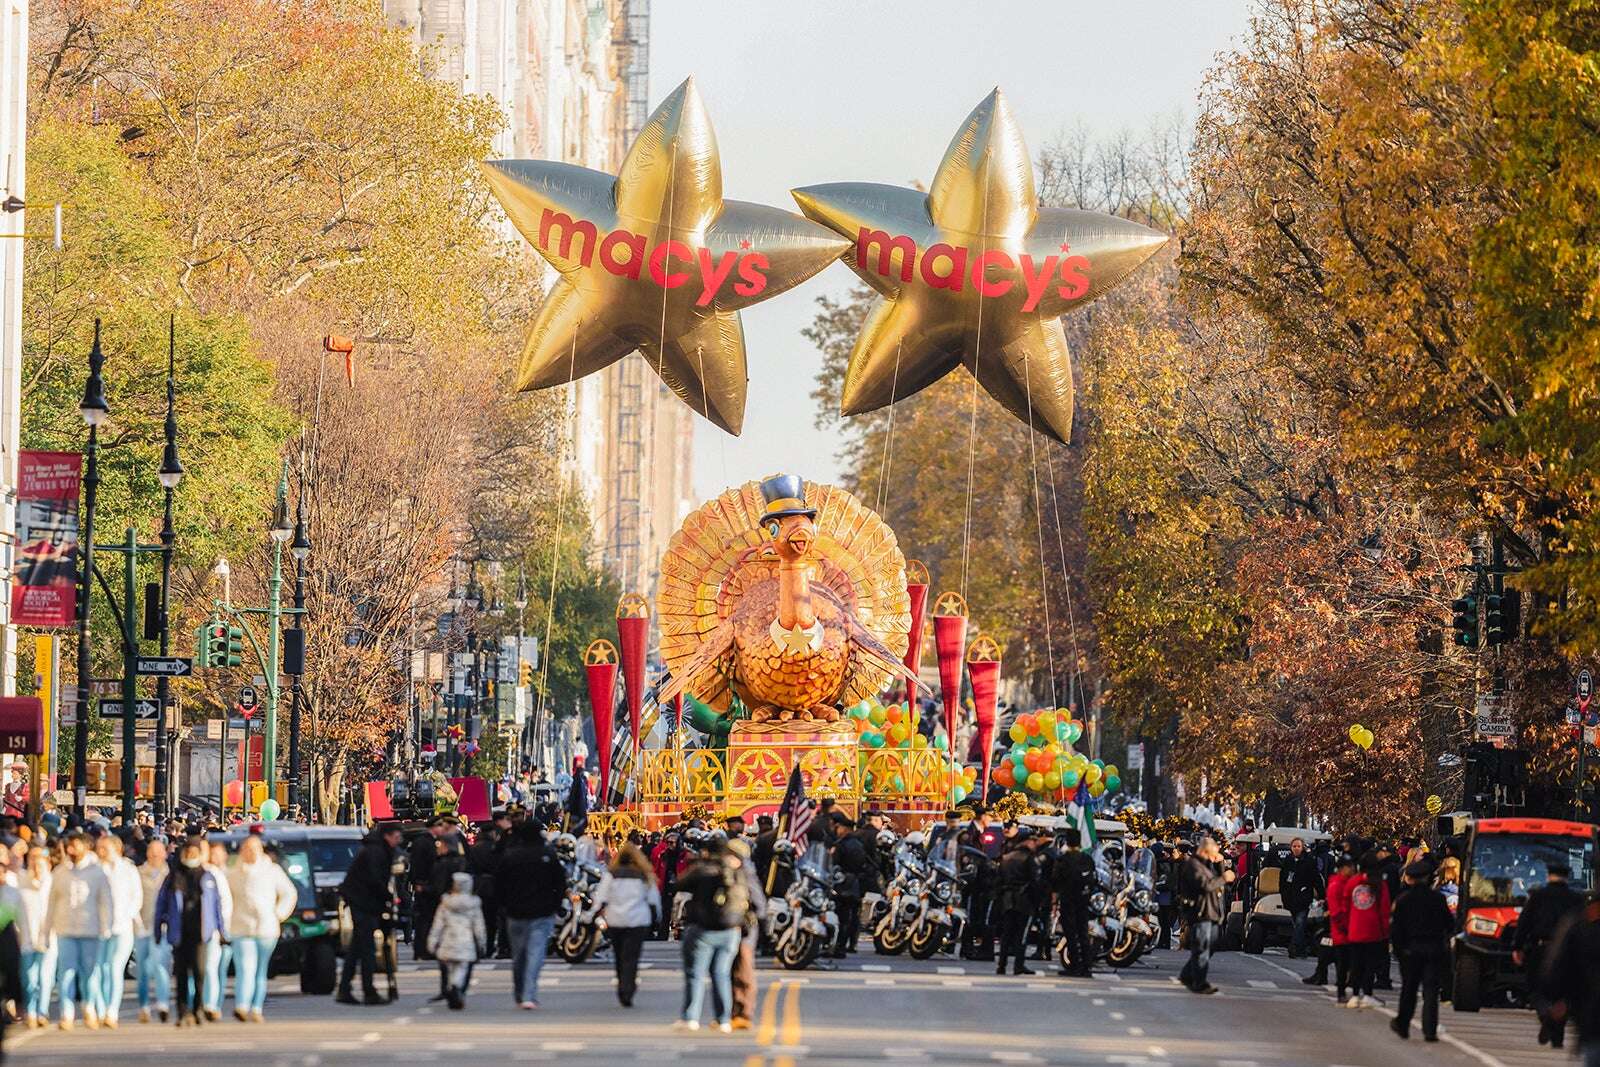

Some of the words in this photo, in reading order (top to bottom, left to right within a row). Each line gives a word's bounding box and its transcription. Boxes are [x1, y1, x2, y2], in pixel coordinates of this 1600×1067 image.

[142, 662, 159, 670] ONE
[166, 662, 184, 670] WAY
[94, 682, 105, 694] 76
[1480, 723, 1512, 732] CAMERA
[8, 736, 26, 748] 151
